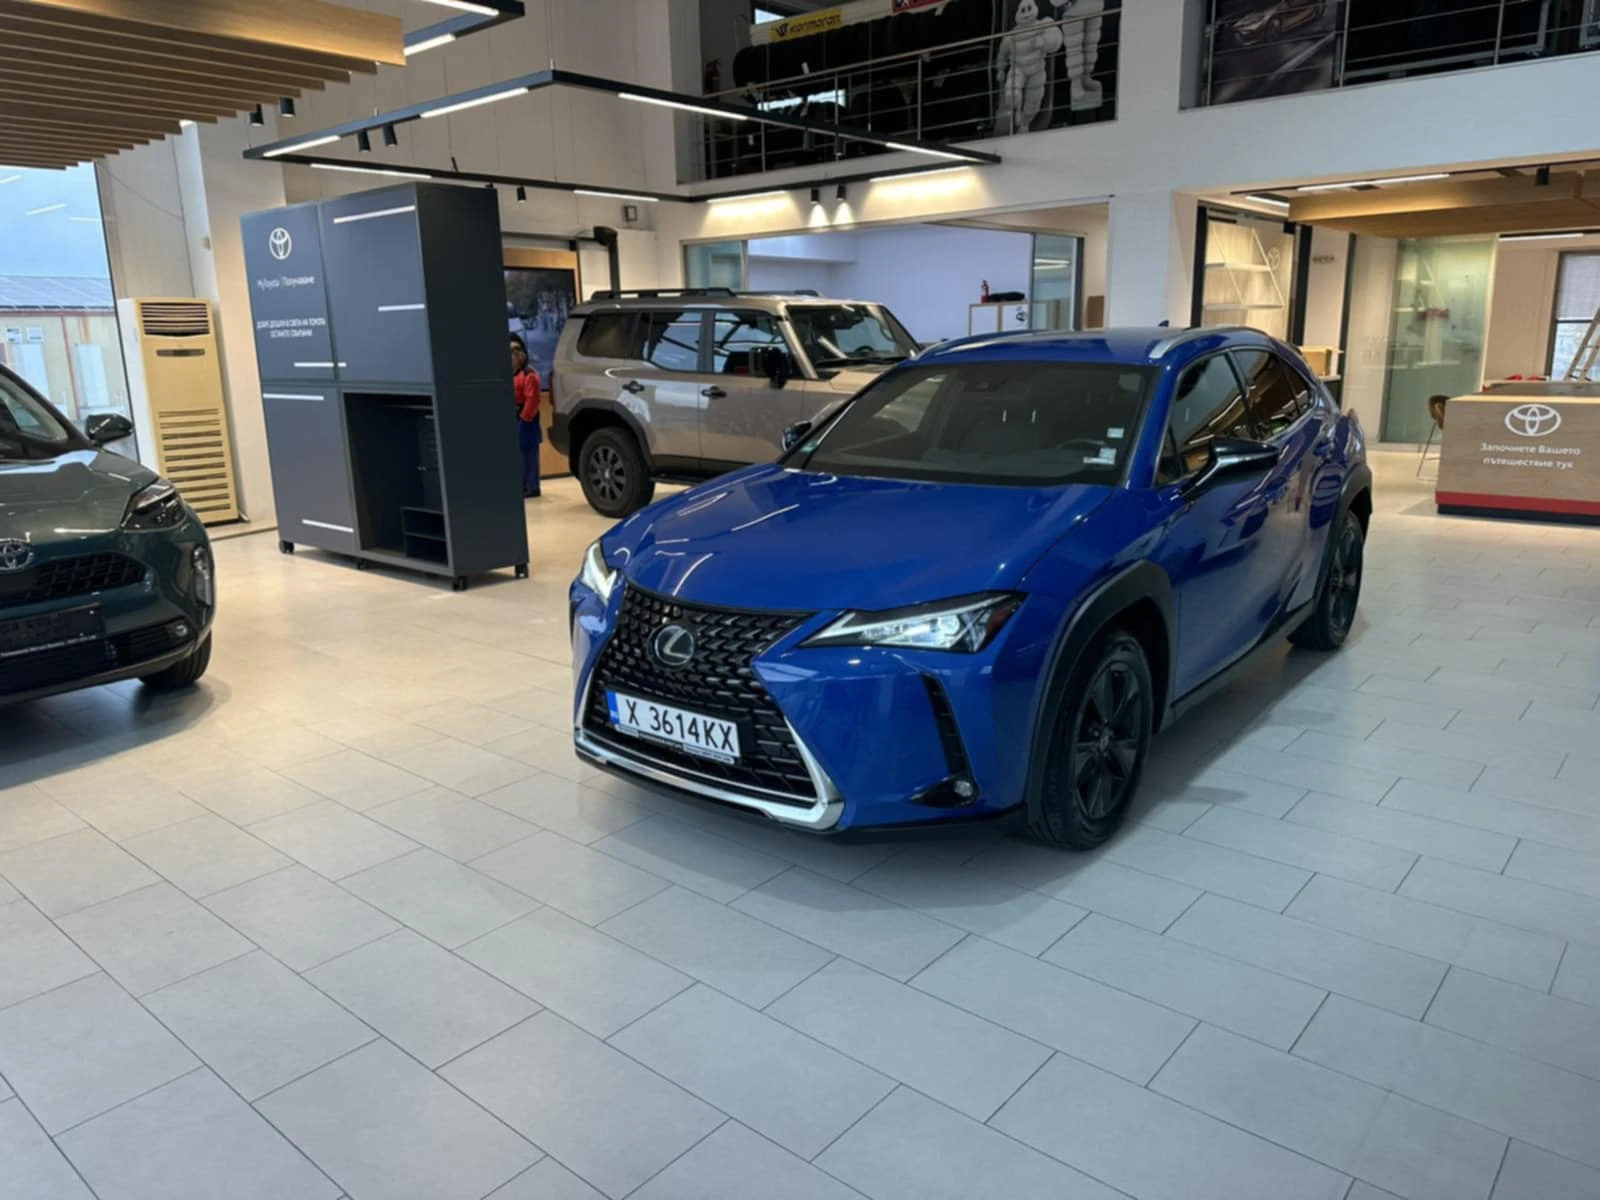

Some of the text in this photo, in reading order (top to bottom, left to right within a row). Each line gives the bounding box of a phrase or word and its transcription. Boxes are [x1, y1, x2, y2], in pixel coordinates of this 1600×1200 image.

[1481, 443, 1581, 455] Започнете Вашето
[1483, 457, 1574, 470] пътешествие тук
[625, 698, 735, 753] X 3614KX
